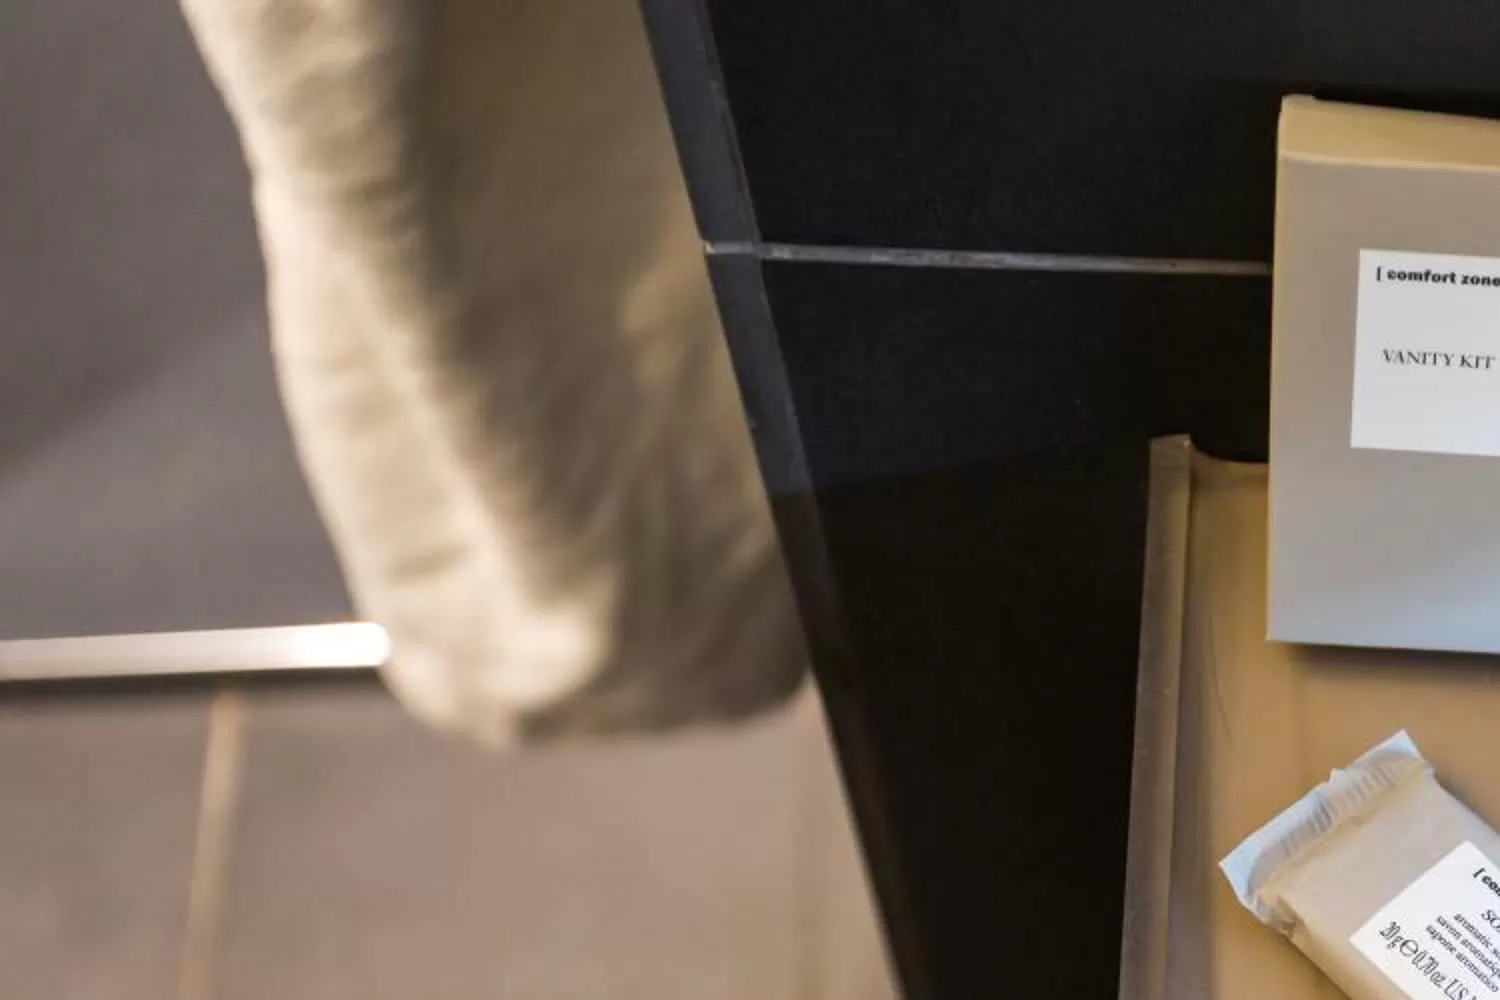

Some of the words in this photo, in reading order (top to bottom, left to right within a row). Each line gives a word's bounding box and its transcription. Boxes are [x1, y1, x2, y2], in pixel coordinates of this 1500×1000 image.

[1387, 269, 1456, 284] comfort
[1382, 348, 1454, 367] VANITY
[1460, 354, 1496, 370] KIT
